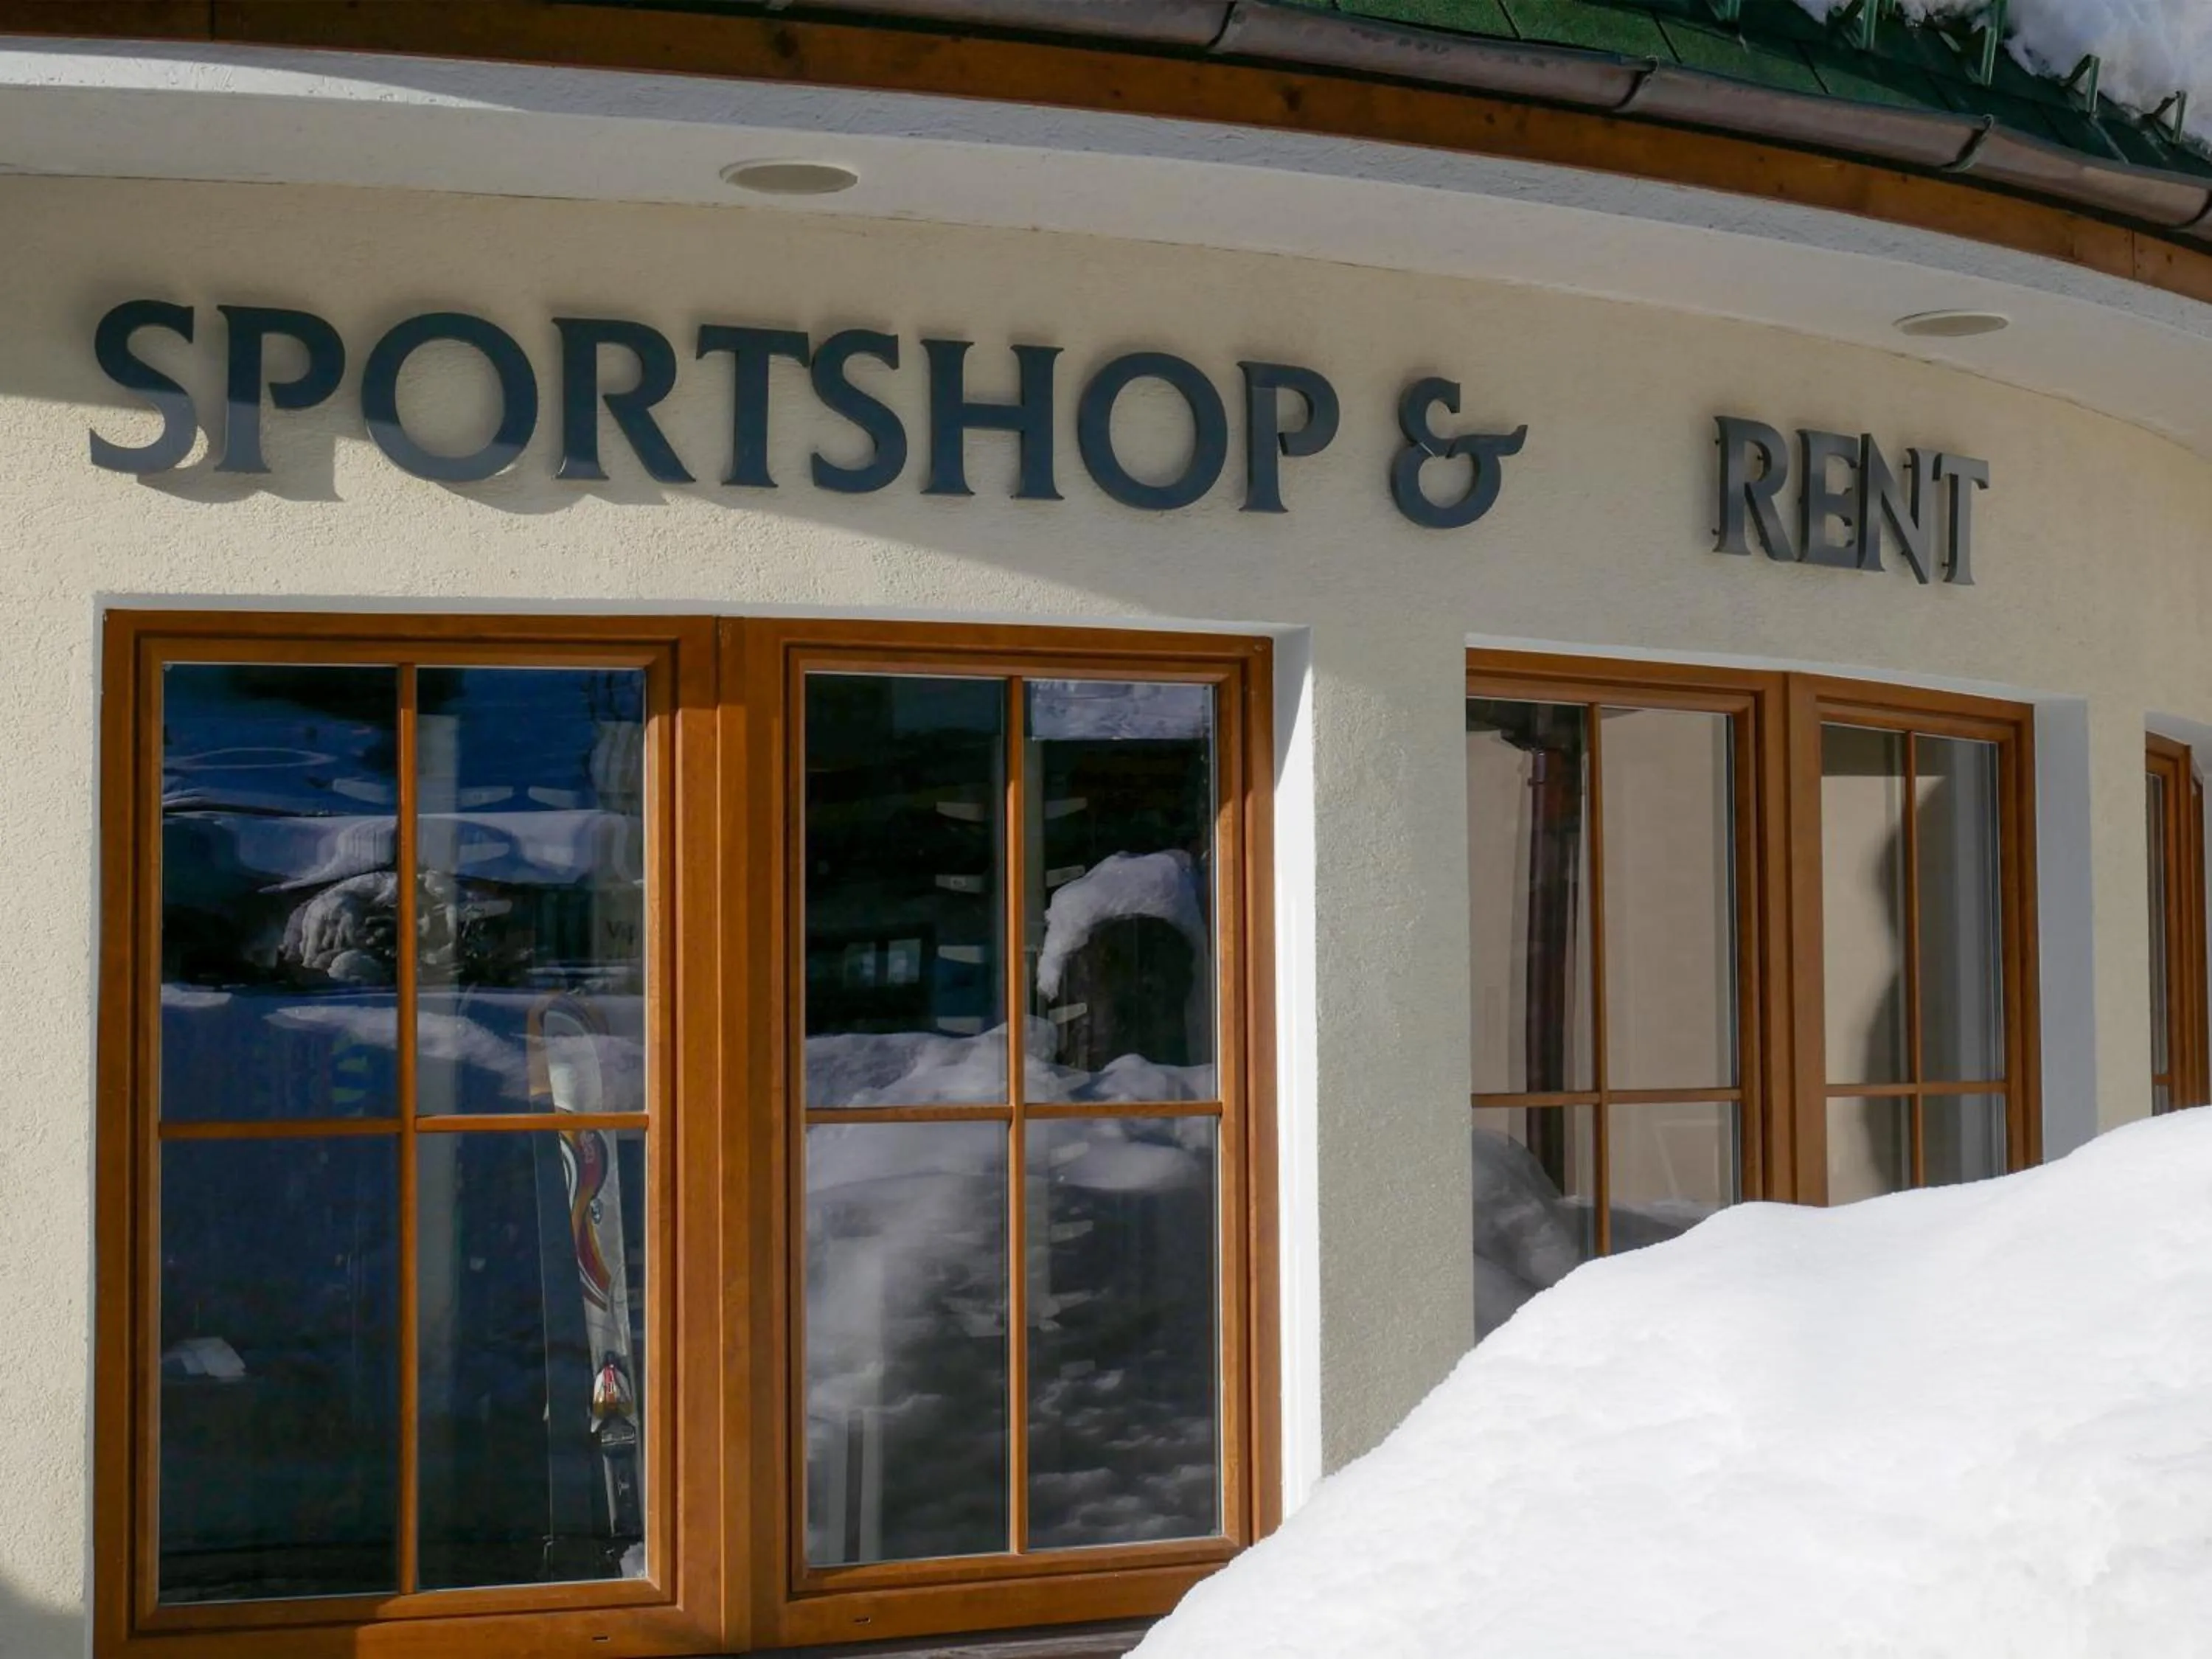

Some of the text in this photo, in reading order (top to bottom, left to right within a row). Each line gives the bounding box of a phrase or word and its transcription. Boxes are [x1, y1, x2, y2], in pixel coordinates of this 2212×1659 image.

[89, 299, 1989, 585] SPORTSHOP & RENT
